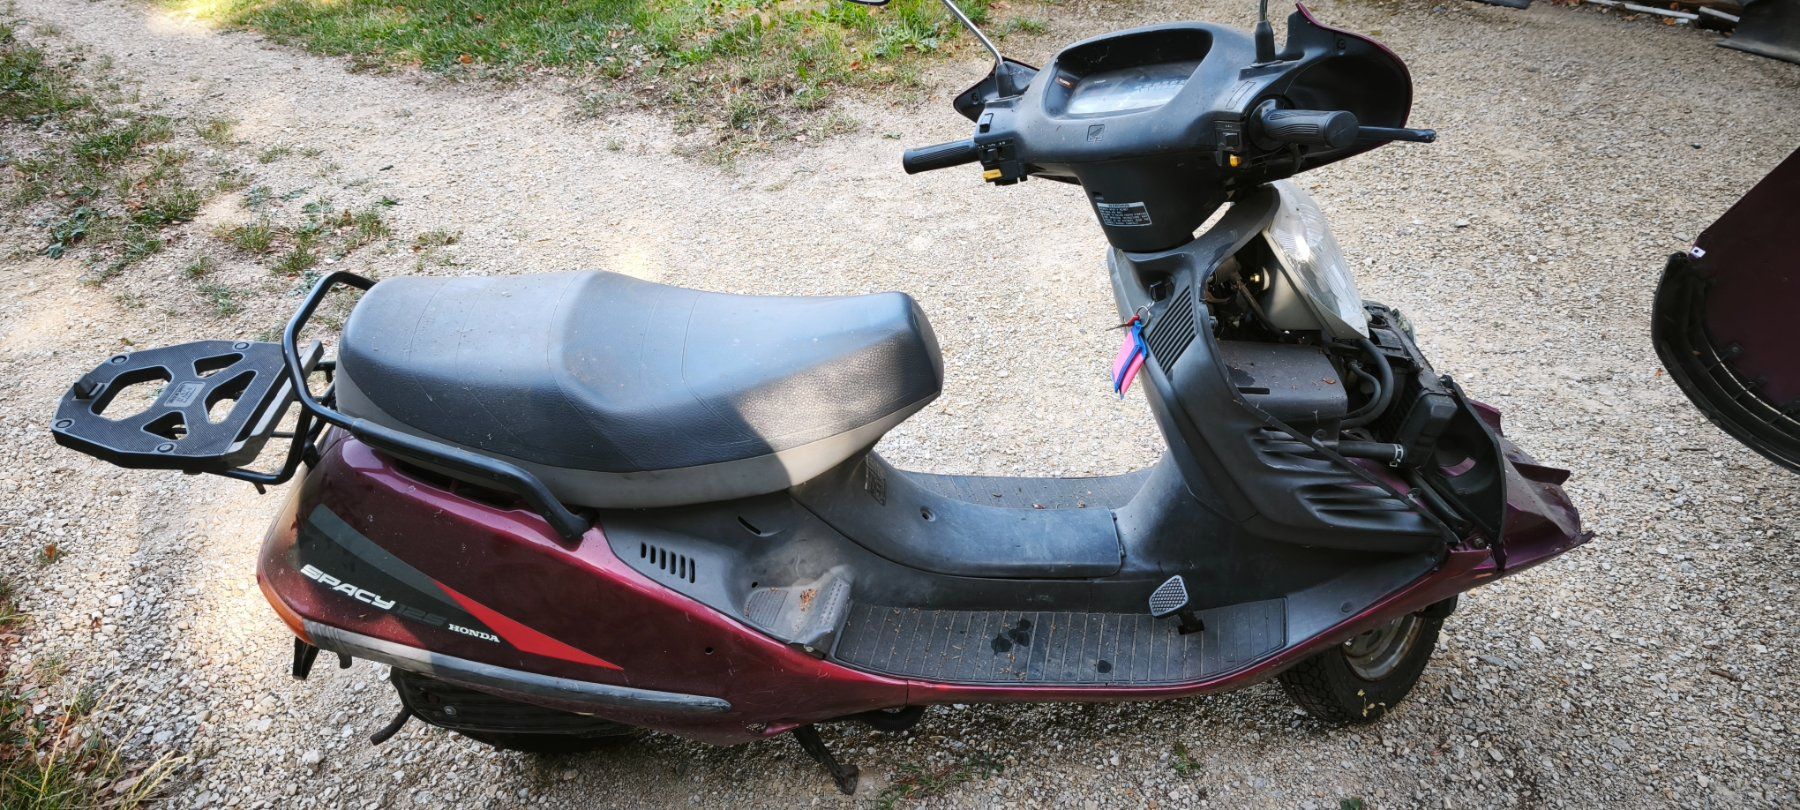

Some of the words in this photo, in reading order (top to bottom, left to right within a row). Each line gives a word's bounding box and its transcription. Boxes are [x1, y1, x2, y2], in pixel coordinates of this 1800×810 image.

[300, 563, 396, 611] SPACY
[396, 603, 448, 626] 125
[448, 623, 501, 644] HONDA
